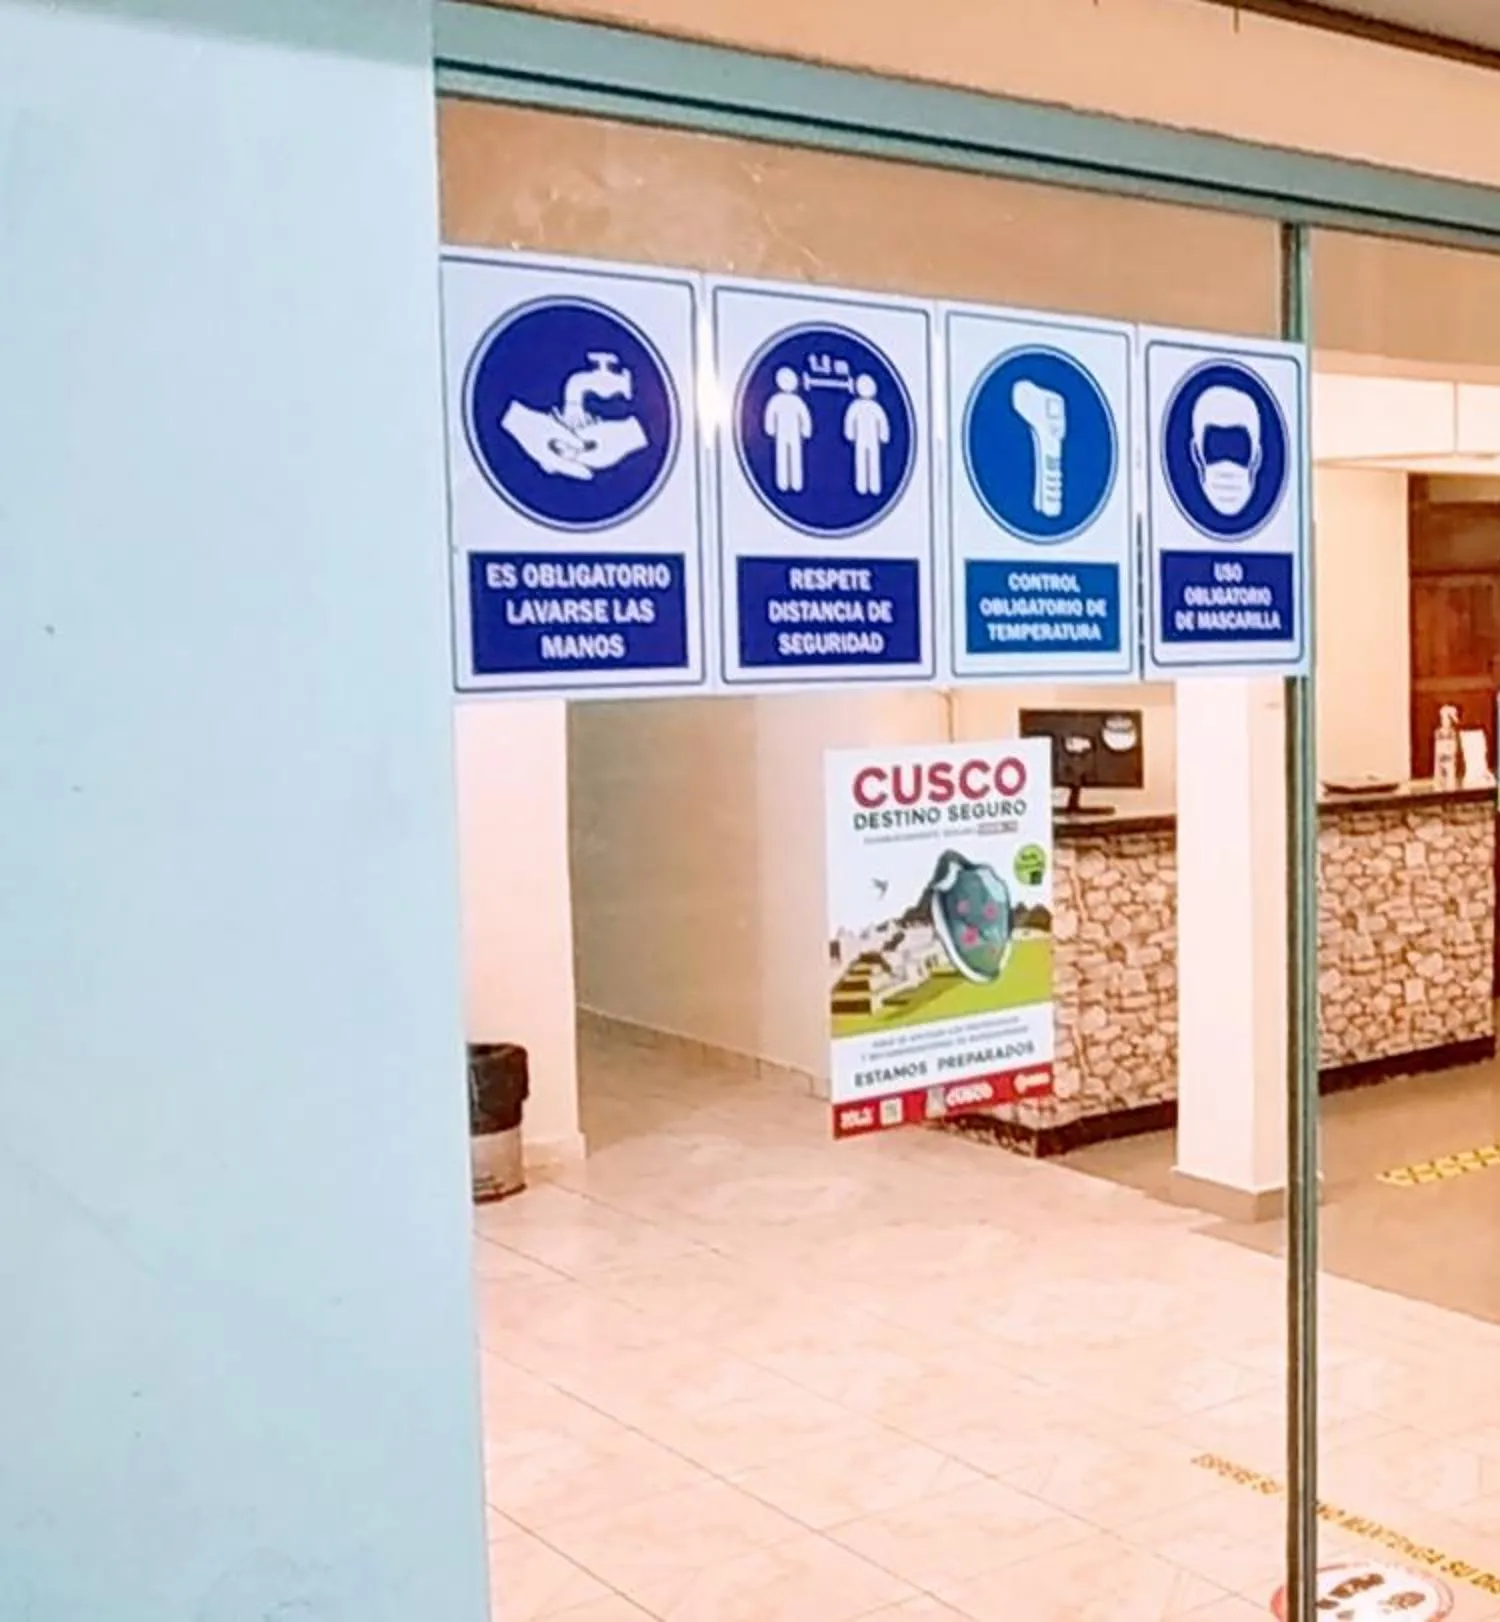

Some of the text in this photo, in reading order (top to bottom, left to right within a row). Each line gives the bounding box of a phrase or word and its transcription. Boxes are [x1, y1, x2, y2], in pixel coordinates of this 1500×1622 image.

[486, 562, 671, 589] ES OBLIGATORIO
[789, 567, 872, 591] RESPETE
[1008, 572, 1081, 593] CONTROL
[1214, 562, 1243, 583] USO
[979, 597, 1107, 618] OBLIGATORIO DE
[1184, 585, 1272, 607] OBLIGATORIO
[506, 598, 655, 624] LAVARSE LAS
[768, 600, 893, 623] DISTANCIA DE
[1175, 610, 1282, 631] DE MASCARILLA
[777, 631, 884, 655] SEGURIDAD
[987, 622, 1102, 641] TEMPERATURA
[541, 634, 626, 659] MANOS
[853, 757, 1027, 809] CUSCO
[853, 799, 1027, 831] DESTINO SEGURO
[854, 1061, 928, 1088] ESTAMOS
[937, 1040, 1035, 1070] PREPARADOS
